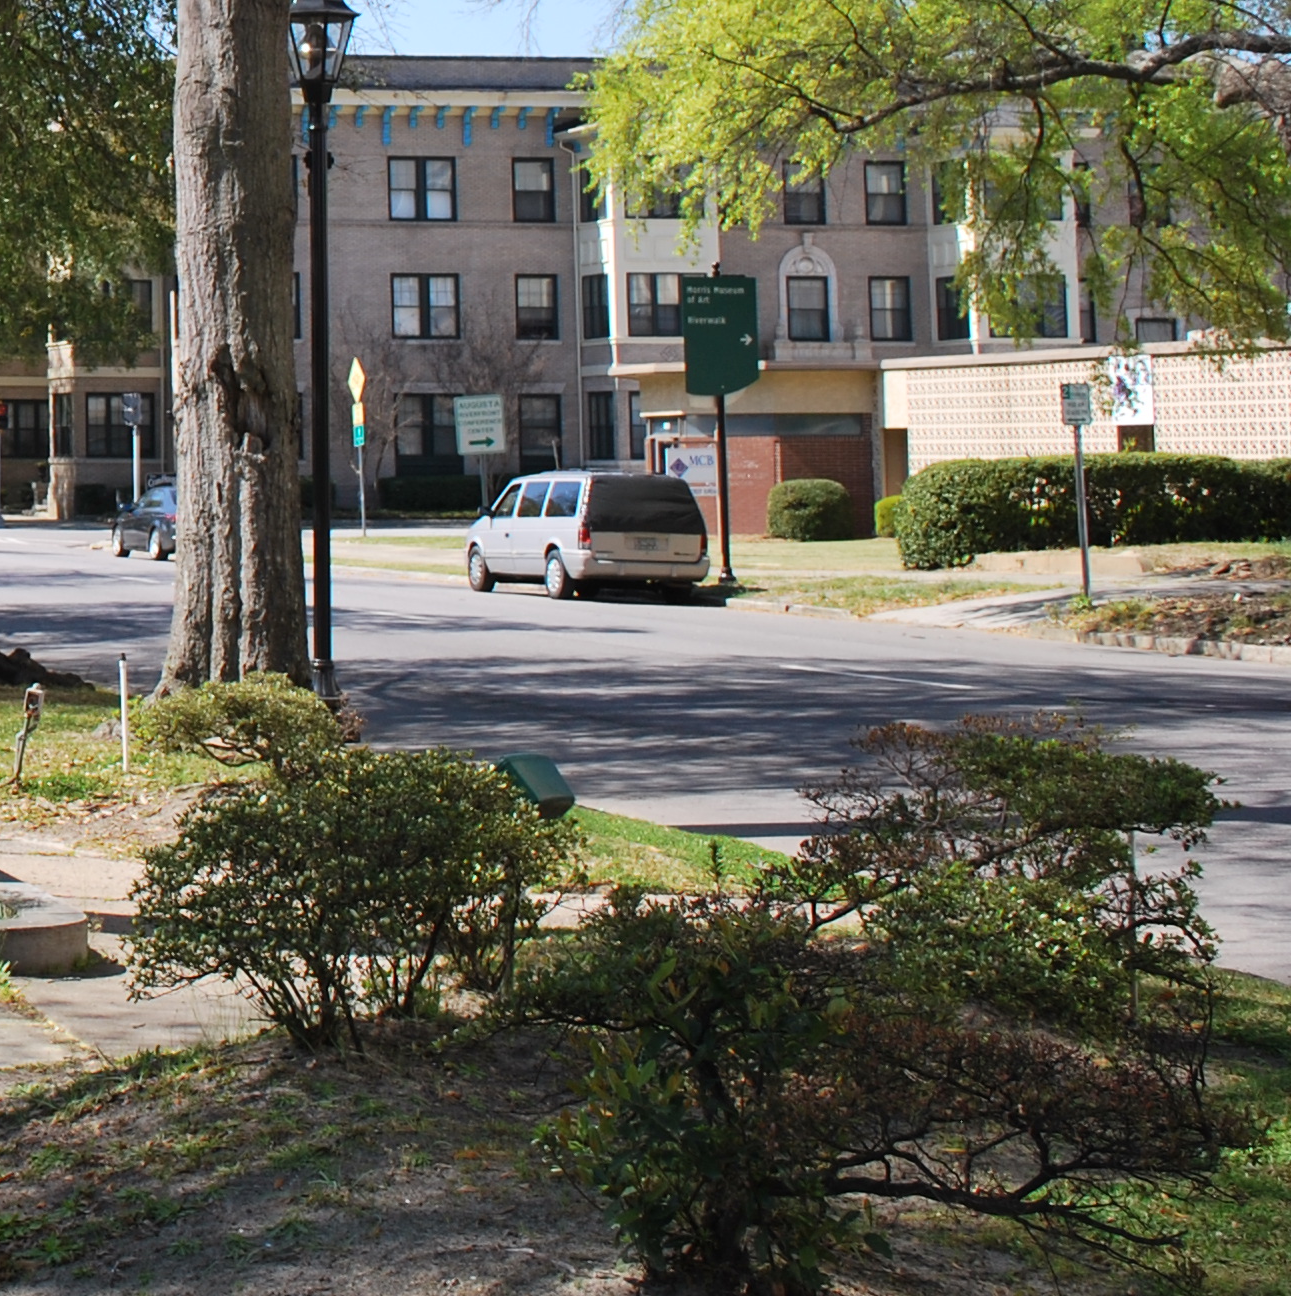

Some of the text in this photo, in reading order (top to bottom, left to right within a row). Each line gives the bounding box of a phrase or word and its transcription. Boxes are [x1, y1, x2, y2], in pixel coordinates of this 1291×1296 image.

[686, 286, 745, 295] Morris Museum
[687, 296, 711, 304] of Art
[687, 316, 727, 324] Riverwalk
[460, 400, 500, 409] AUGUSTA
[460, 409, 501, 418] RIVERFRONT
[459, 418, 502, 427] CONFERENCE
[689, 455, 715, 466] MCB
